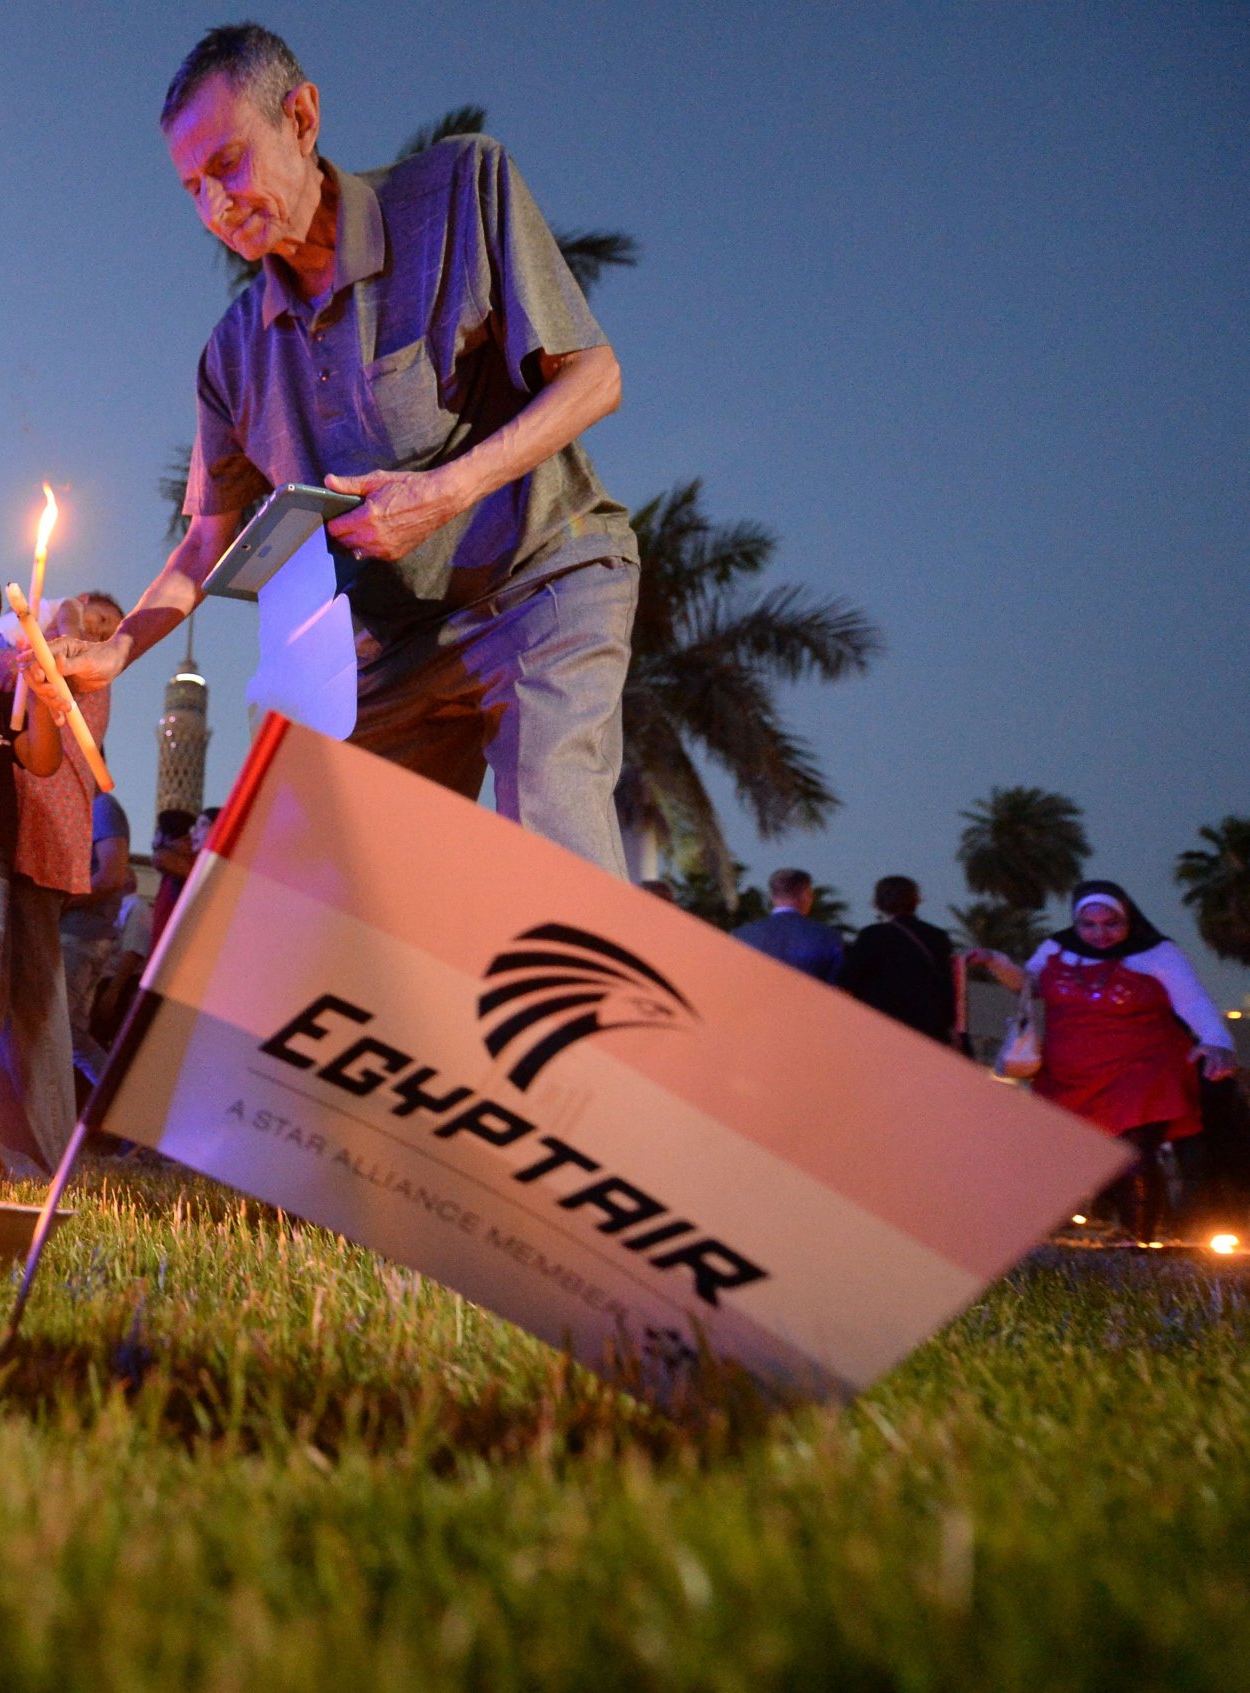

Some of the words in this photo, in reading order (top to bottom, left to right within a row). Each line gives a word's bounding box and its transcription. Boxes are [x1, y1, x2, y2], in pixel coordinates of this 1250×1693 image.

[227, 1100, 246, 1118] A
[253, 1113, 326, 1155] STAR
[331, 1149, 480, 1233] ALLIANCE
[259, 993, 769, 1306] EGYPTAIR
